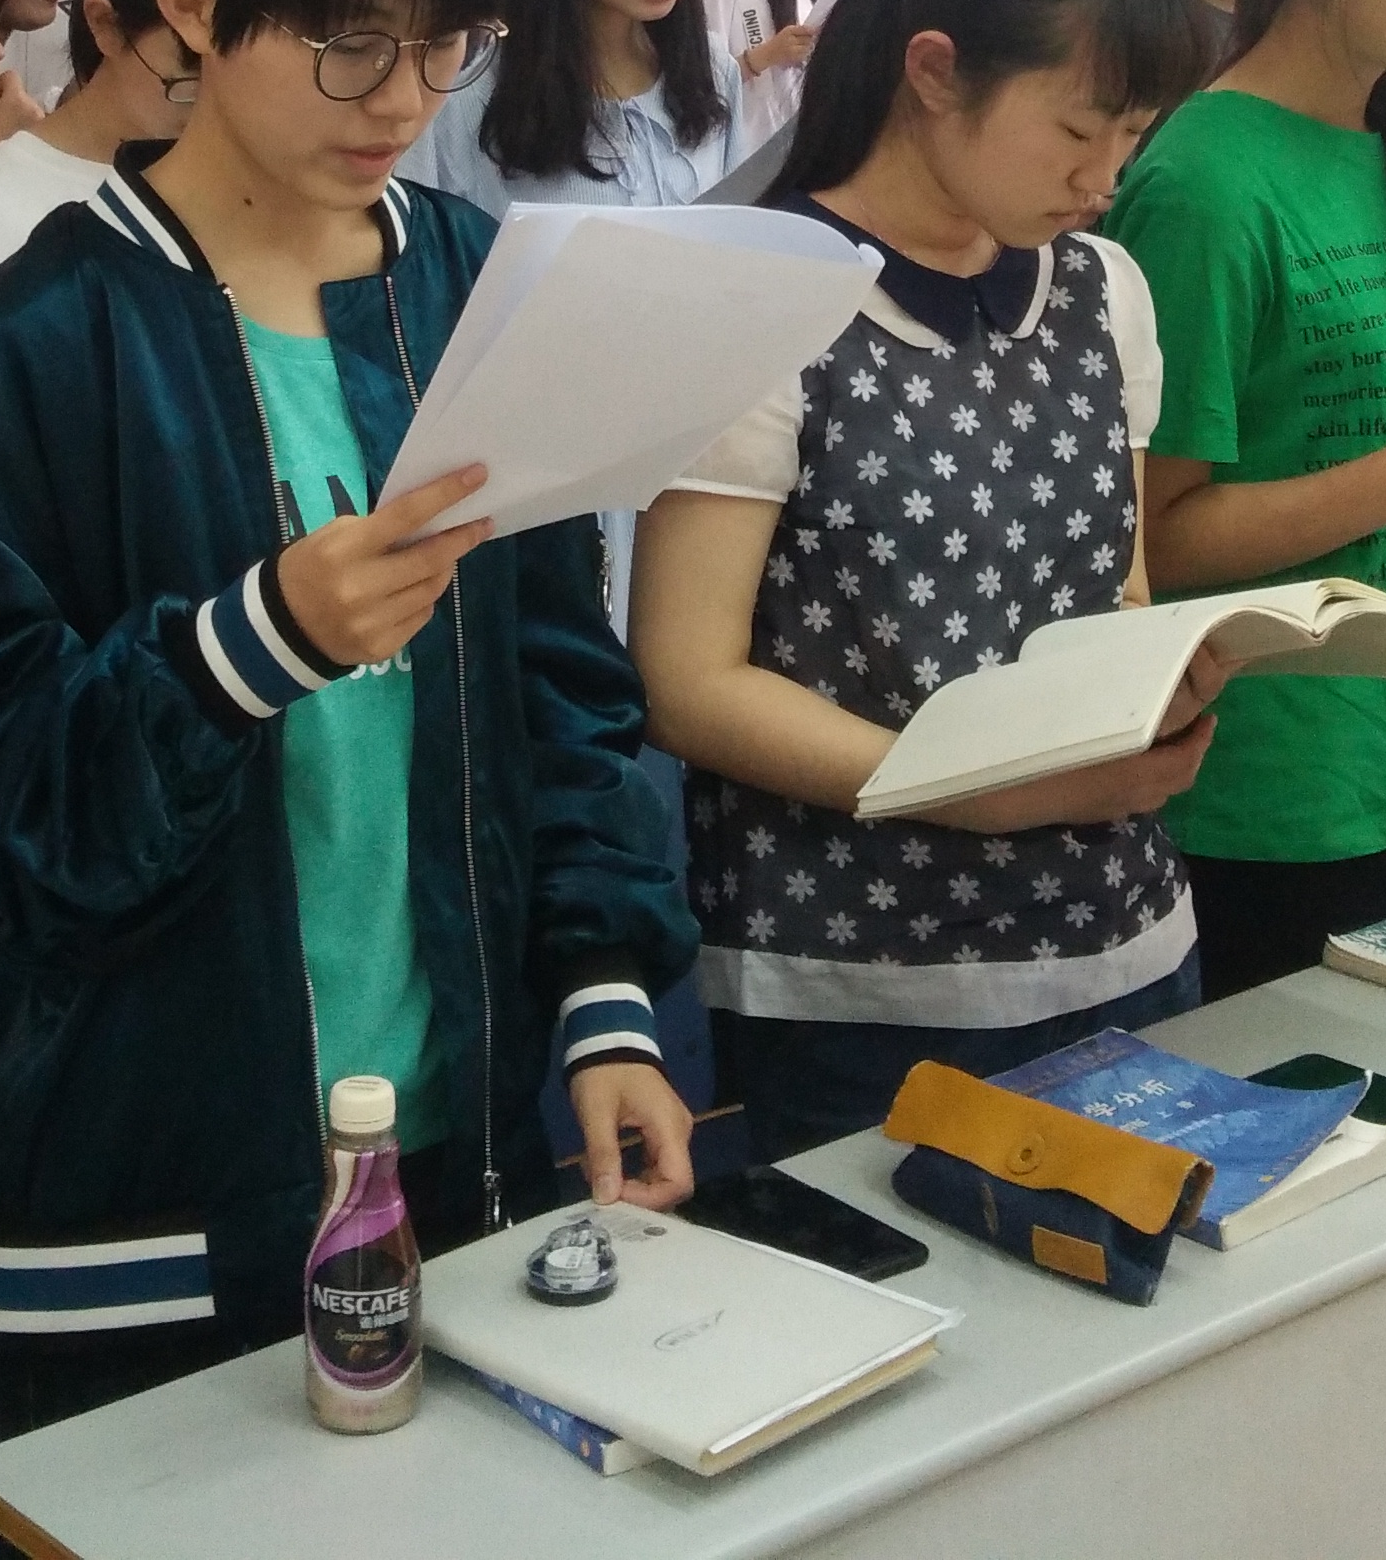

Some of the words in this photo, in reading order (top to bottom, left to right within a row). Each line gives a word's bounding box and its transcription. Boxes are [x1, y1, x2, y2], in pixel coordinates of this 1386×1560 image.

[743, 9, 763, 49] CHINO
[1326, 244, 1356, 263] that
[1295, 286, 1332, 314] your
[1335, 277, 1361, 297] life
[1299, 320, 1356, 345] There
[1362, 314, 1384, 331] are
[1304, 357, 1344, 376] stay
